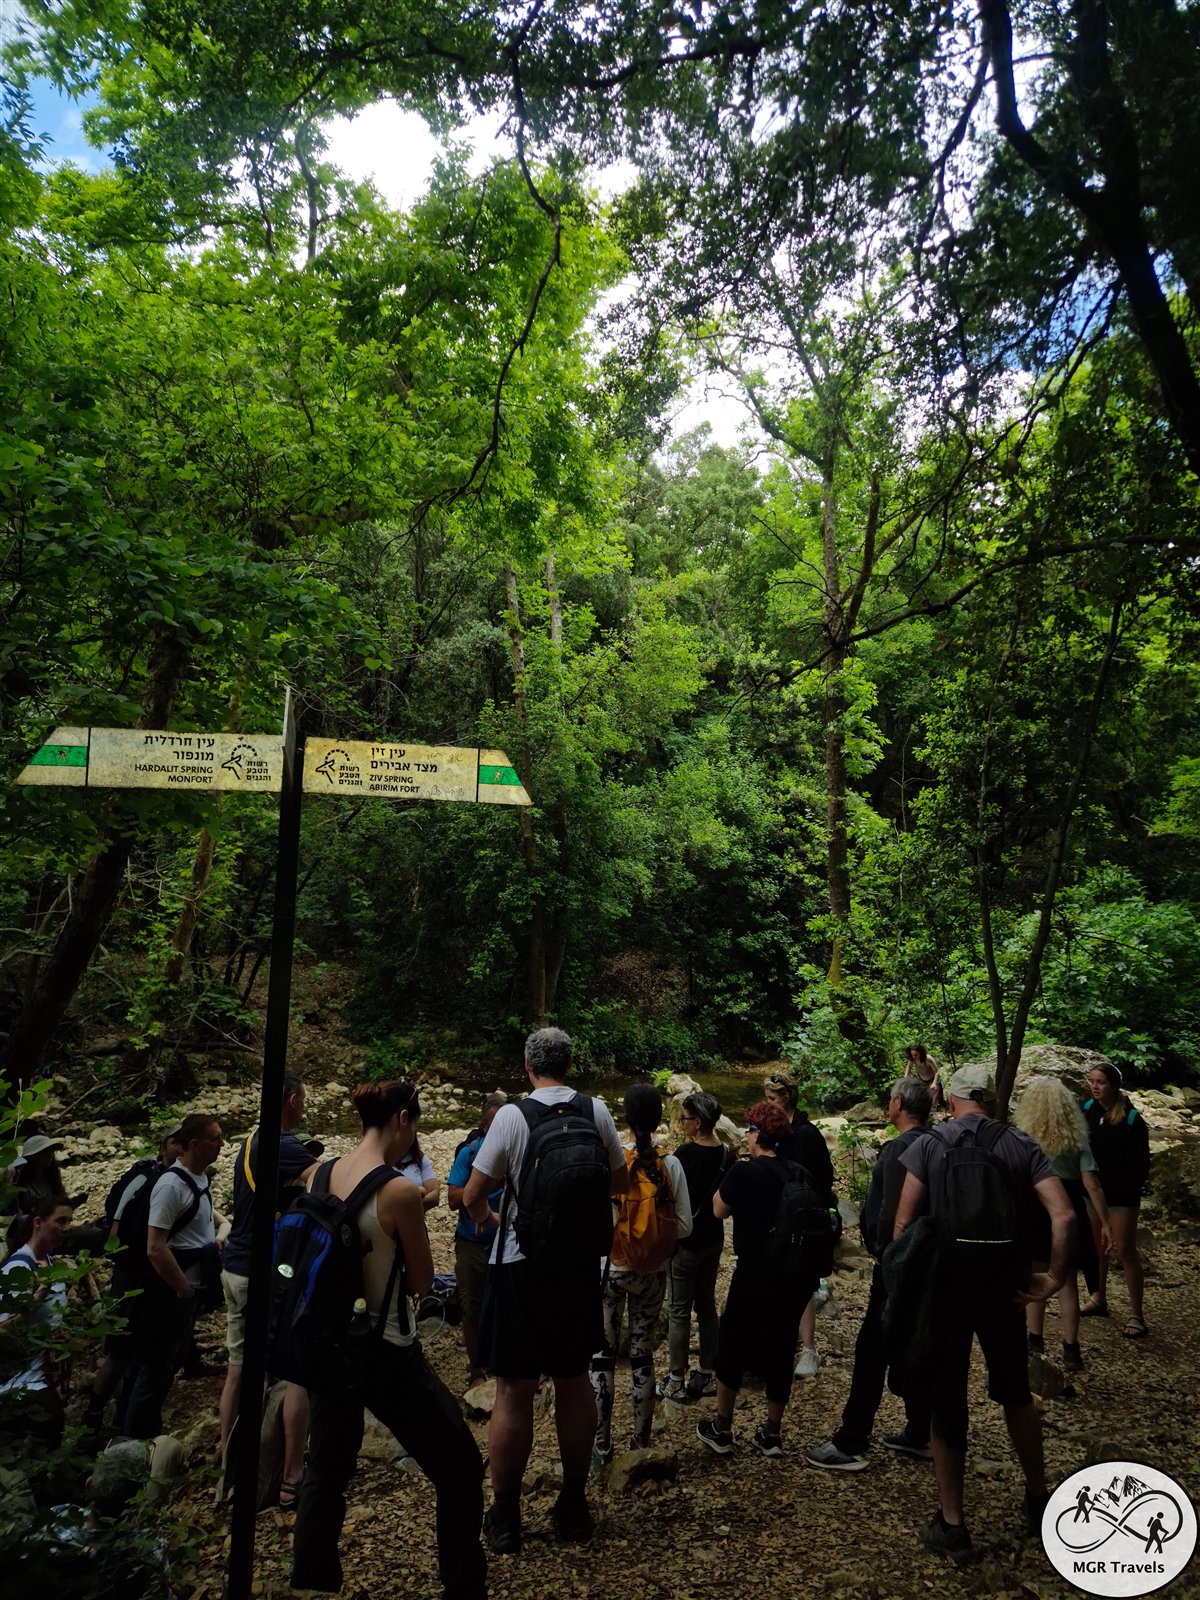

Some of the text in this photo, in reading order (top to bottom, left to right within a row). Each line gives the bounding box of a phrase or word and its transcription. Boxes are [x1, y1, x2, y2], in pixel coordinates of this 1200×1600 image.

[144, 735, 215, 749] עין חרדלית
[174, 751, 214, 761] מונפור
[389, 748, 406, 759] עין
[134, 764, 213, 774] HARDALIT SPRING
[370, 760, 438, 773] מצד אבירים
[167, 775, 213, 784] MONFORT
[369, 774, 413, 784] ZIV SPRING
[369, 784, 398, 792] ABIRIM
[400, 785, 420, 794] FORT
